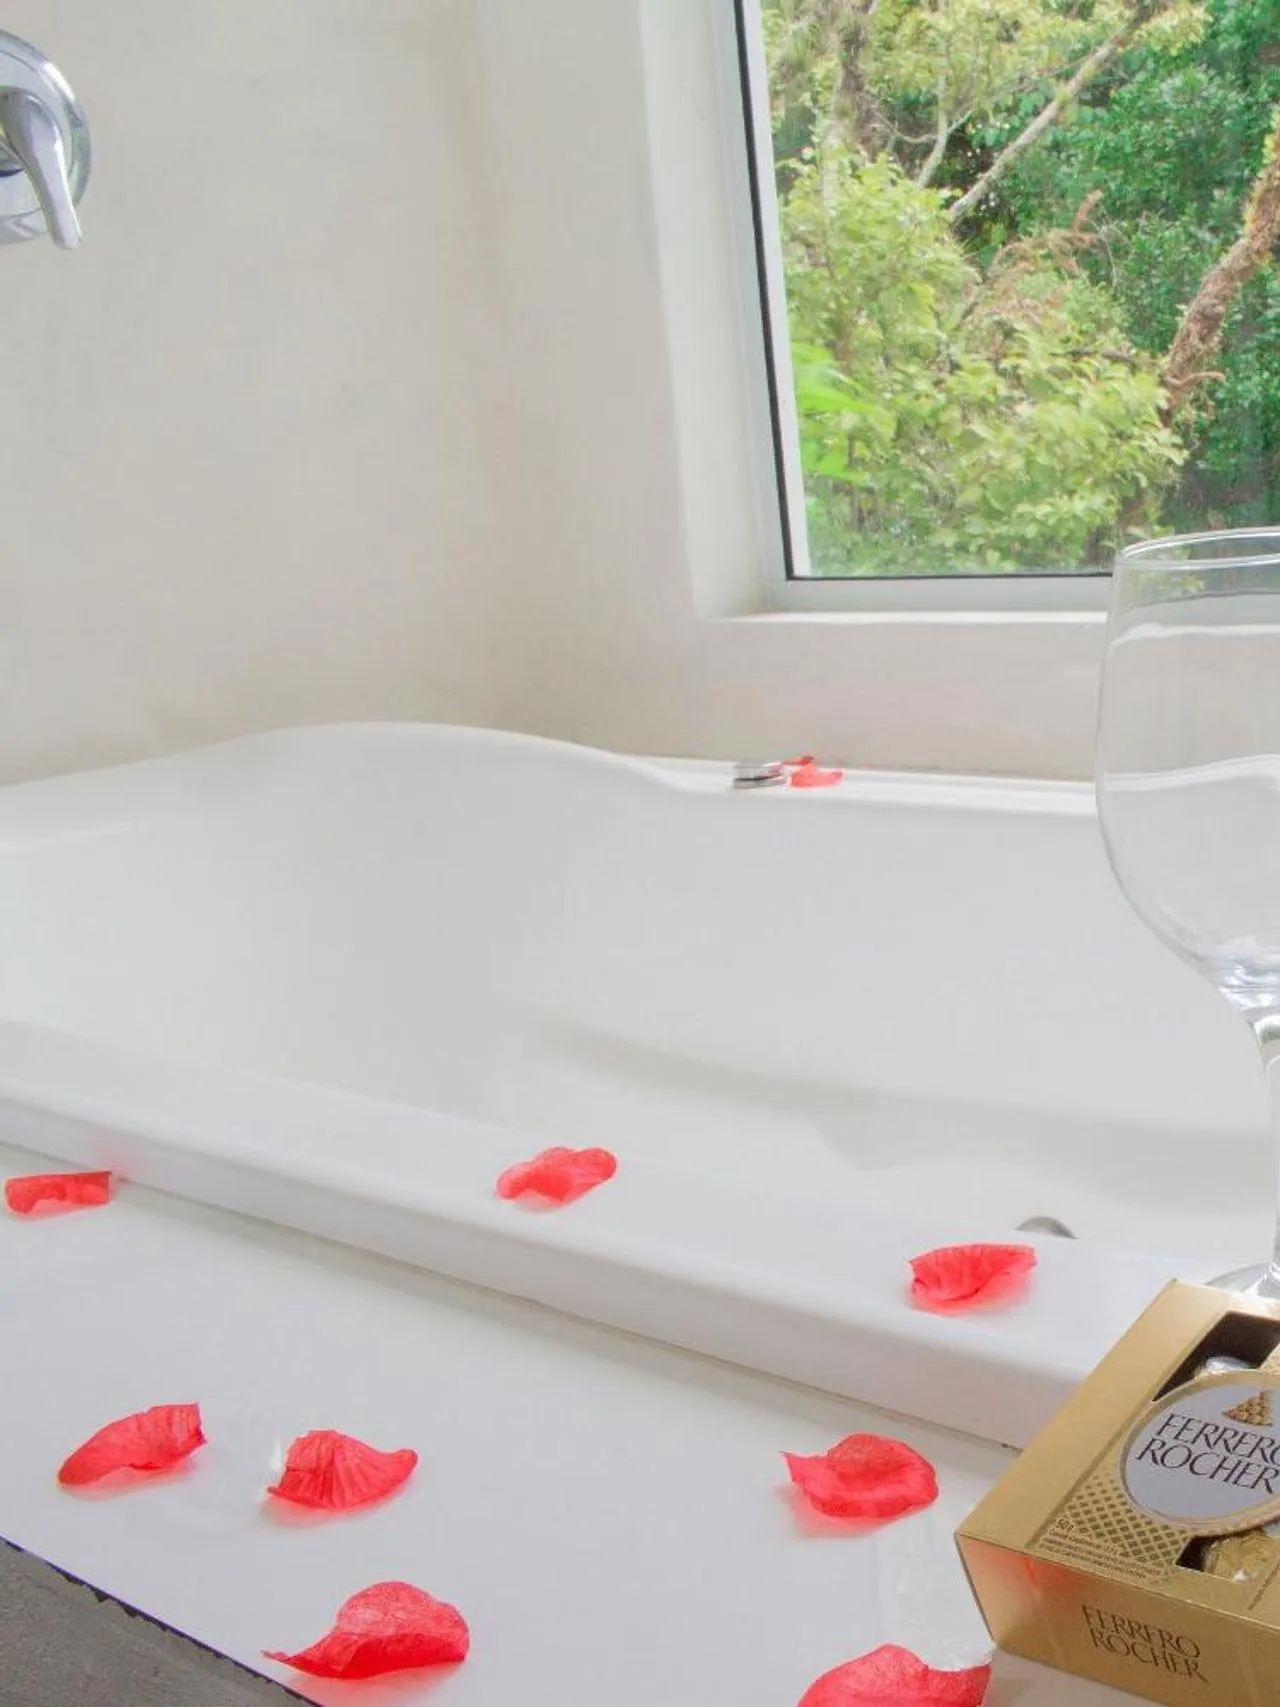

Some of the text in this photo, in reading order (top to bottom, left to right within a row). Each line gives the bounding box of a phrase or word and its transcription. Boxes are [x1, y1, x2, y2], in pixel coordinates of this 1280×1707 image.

[1135, 1437, 1280, 1494] ROCHER
[1082, 1604, 1201, 1658] FERRERO
[1089, 1628, 1209, 1684] ROCHER
